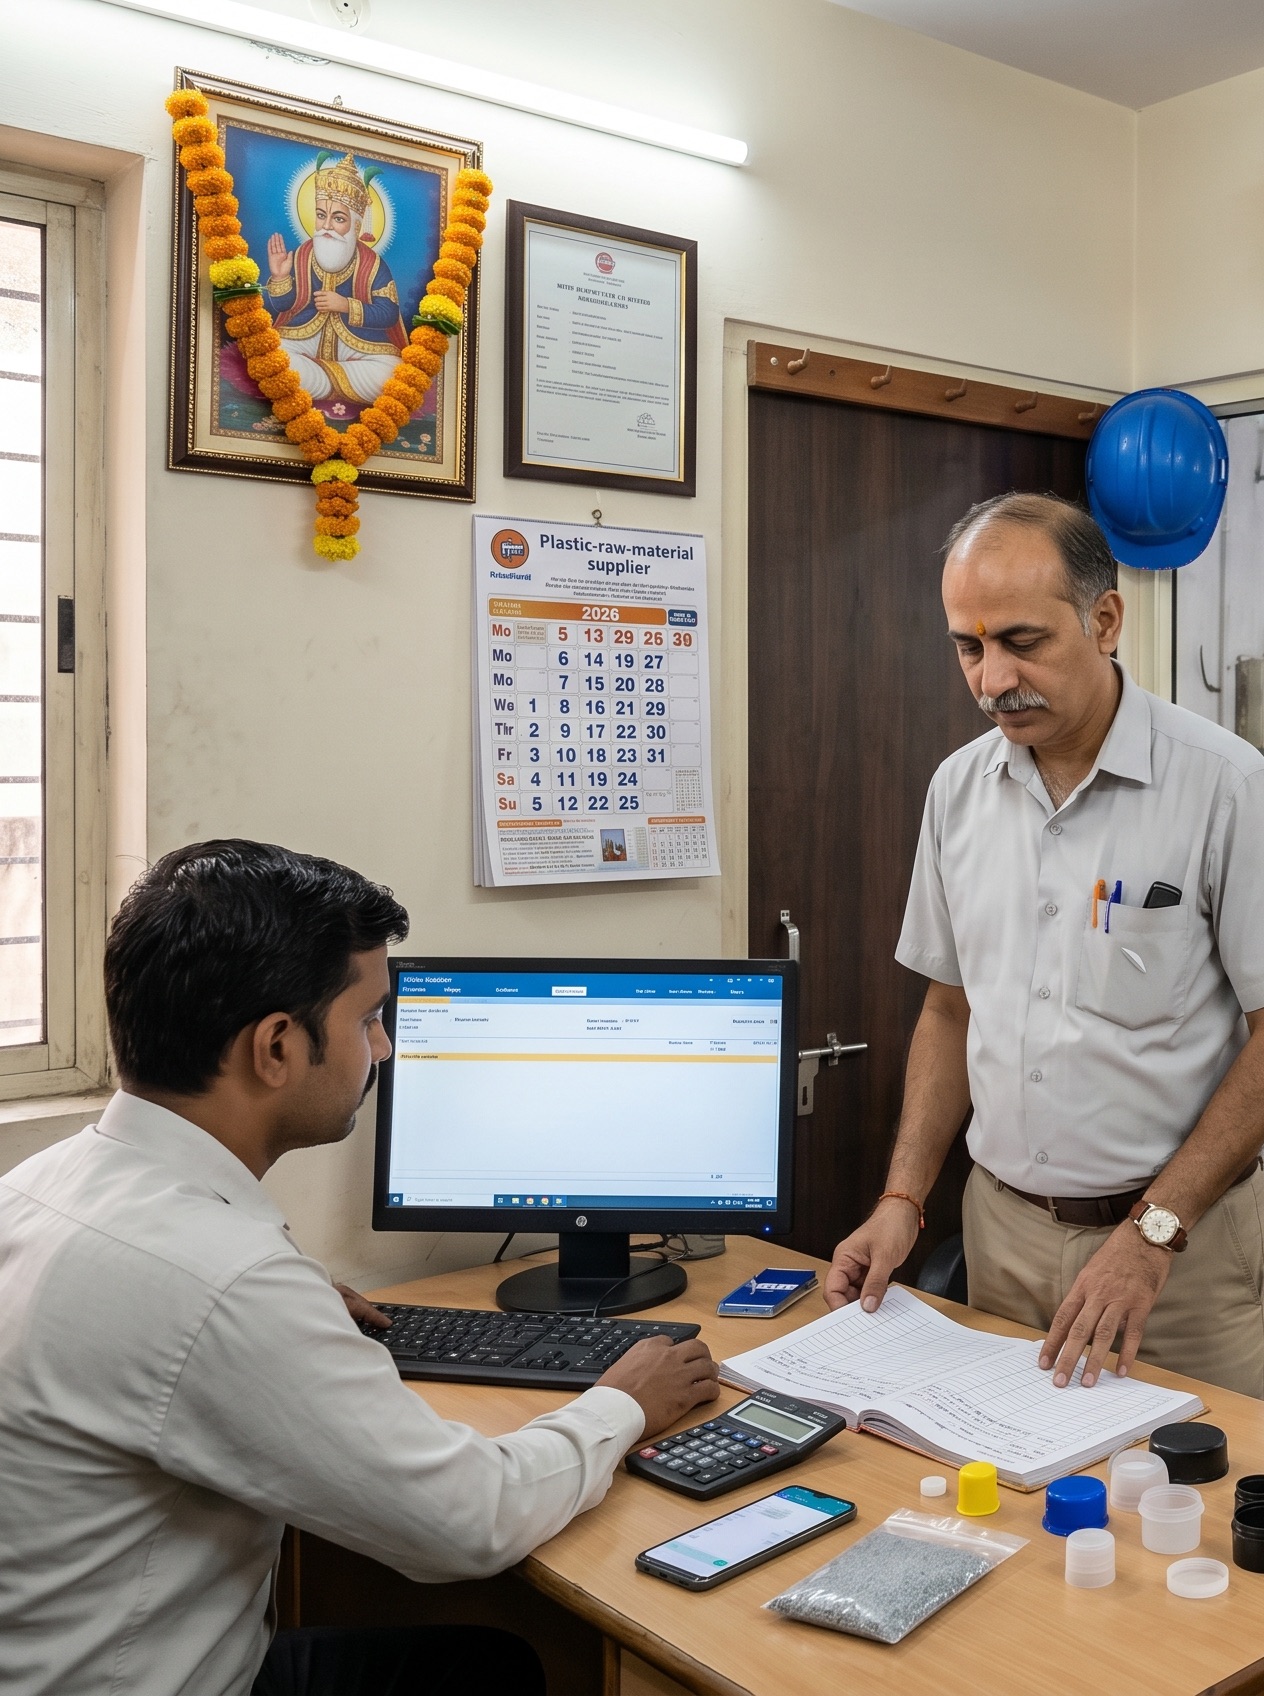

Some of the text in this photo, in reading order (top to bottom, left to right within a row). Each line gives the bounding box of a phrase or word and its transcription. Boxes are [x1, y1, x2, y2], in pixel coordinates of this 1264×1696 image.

[540, 533, 694, 561] Plastic-raw-material
[588, 559, 651, 577] supplier
[581, 606, 620, 621] 2026
[492, 624, 511, 637] Mo
[558, 626, 568, 641] 5
[584, 628, 604, 643] 13
[614, 630, 634, 644] 29
[643, 631, 664, 646] 26
[492, 649, 664, 669] Mo 6 14 19 27
[493, 673, 665, 693] Mo 7 15 20 28
[529, 698, 536, 713] 1
[560, 699, 570, 714] 8
[586, 700, 605, 715] 16
[616, 700, 634, 715] 21
[645, 701, 666, 716] 29
[529, 723, 540, 738] 2
[560, 723, 571, 738] 9
[586, 724, 605, 739] 17
[616, 724, 637, 739] 22
[646, 725, 666, 740] 30
[497, 747, 665, 763] Fr 3 10 18 23 31
[497, 772, 638, 787] Sa 4 11 19 24
[498, 796, 639, 811] Su 5 12 22 25
